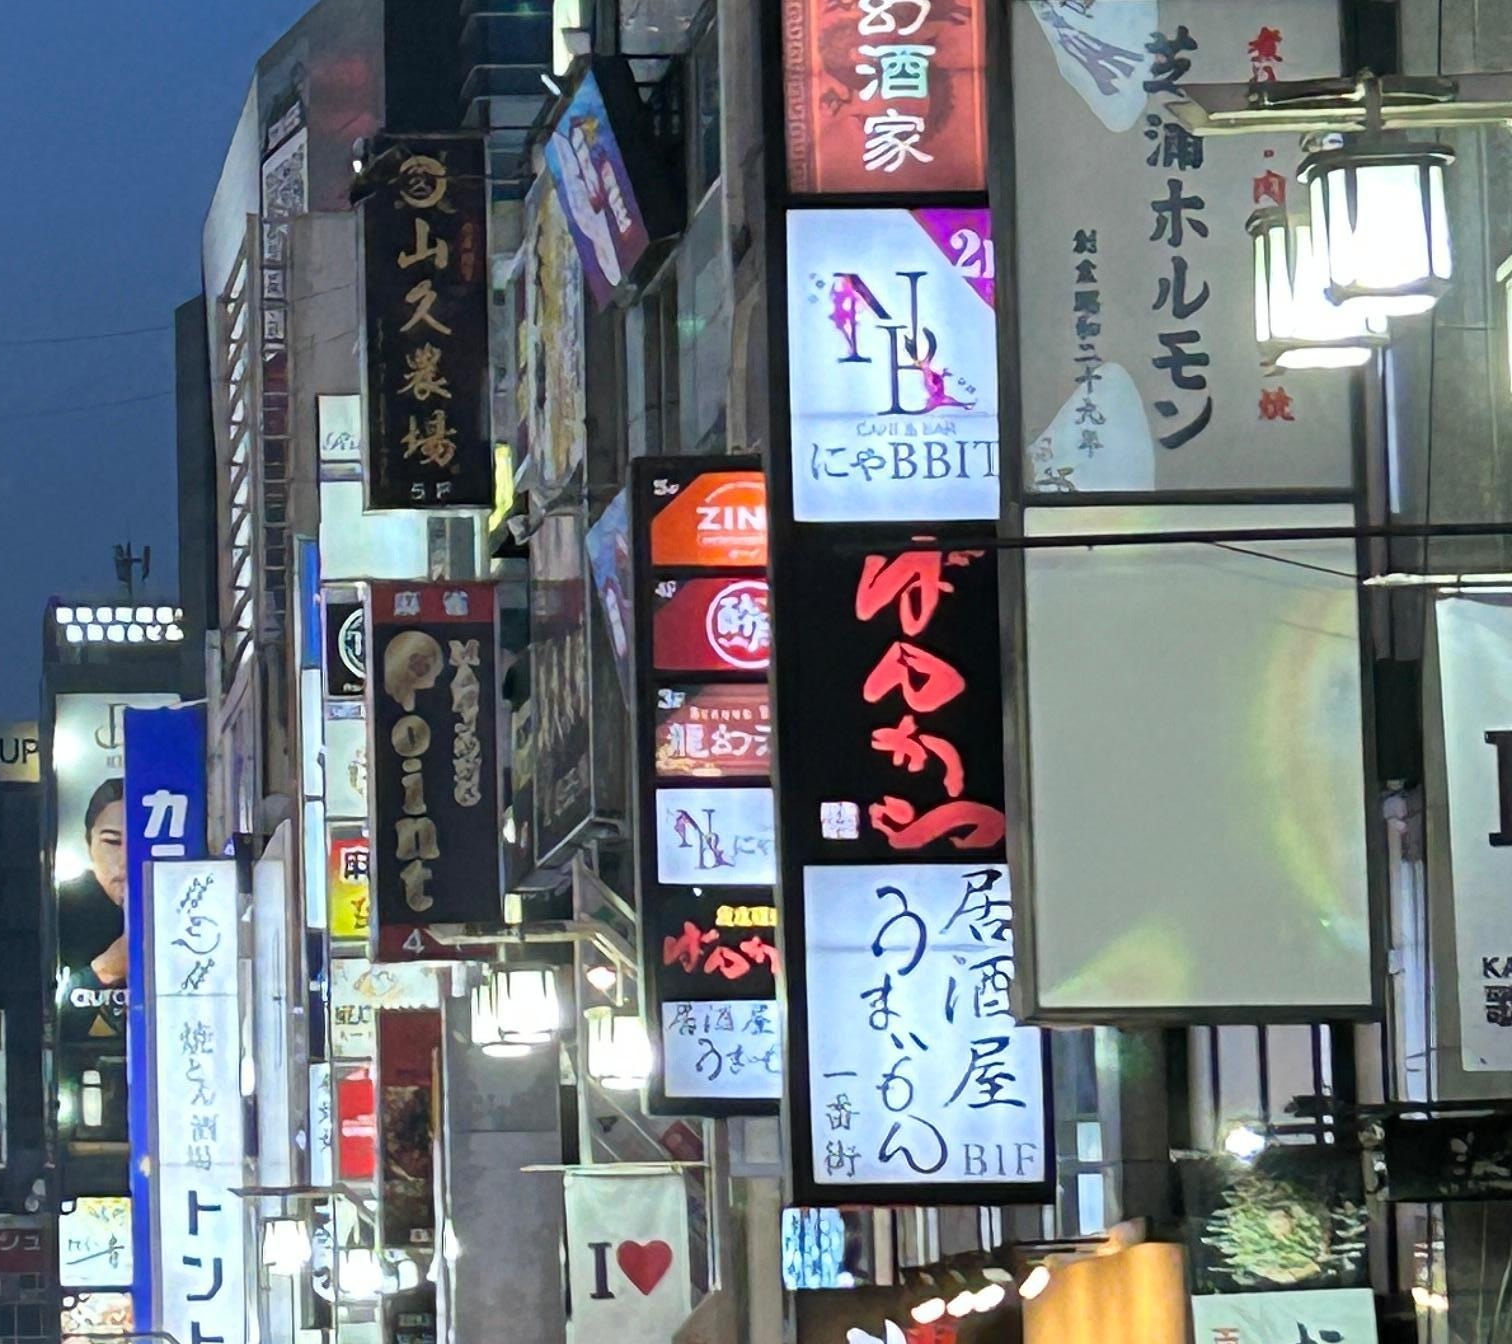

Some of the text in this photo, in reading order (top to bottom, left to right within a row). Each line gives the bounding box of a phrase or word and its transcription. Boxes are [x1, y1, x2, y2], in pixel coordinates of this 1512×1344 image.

[939, 868, 1026, 1109] 居酒屋
[964, 1143, 1037, 1176] B1F
